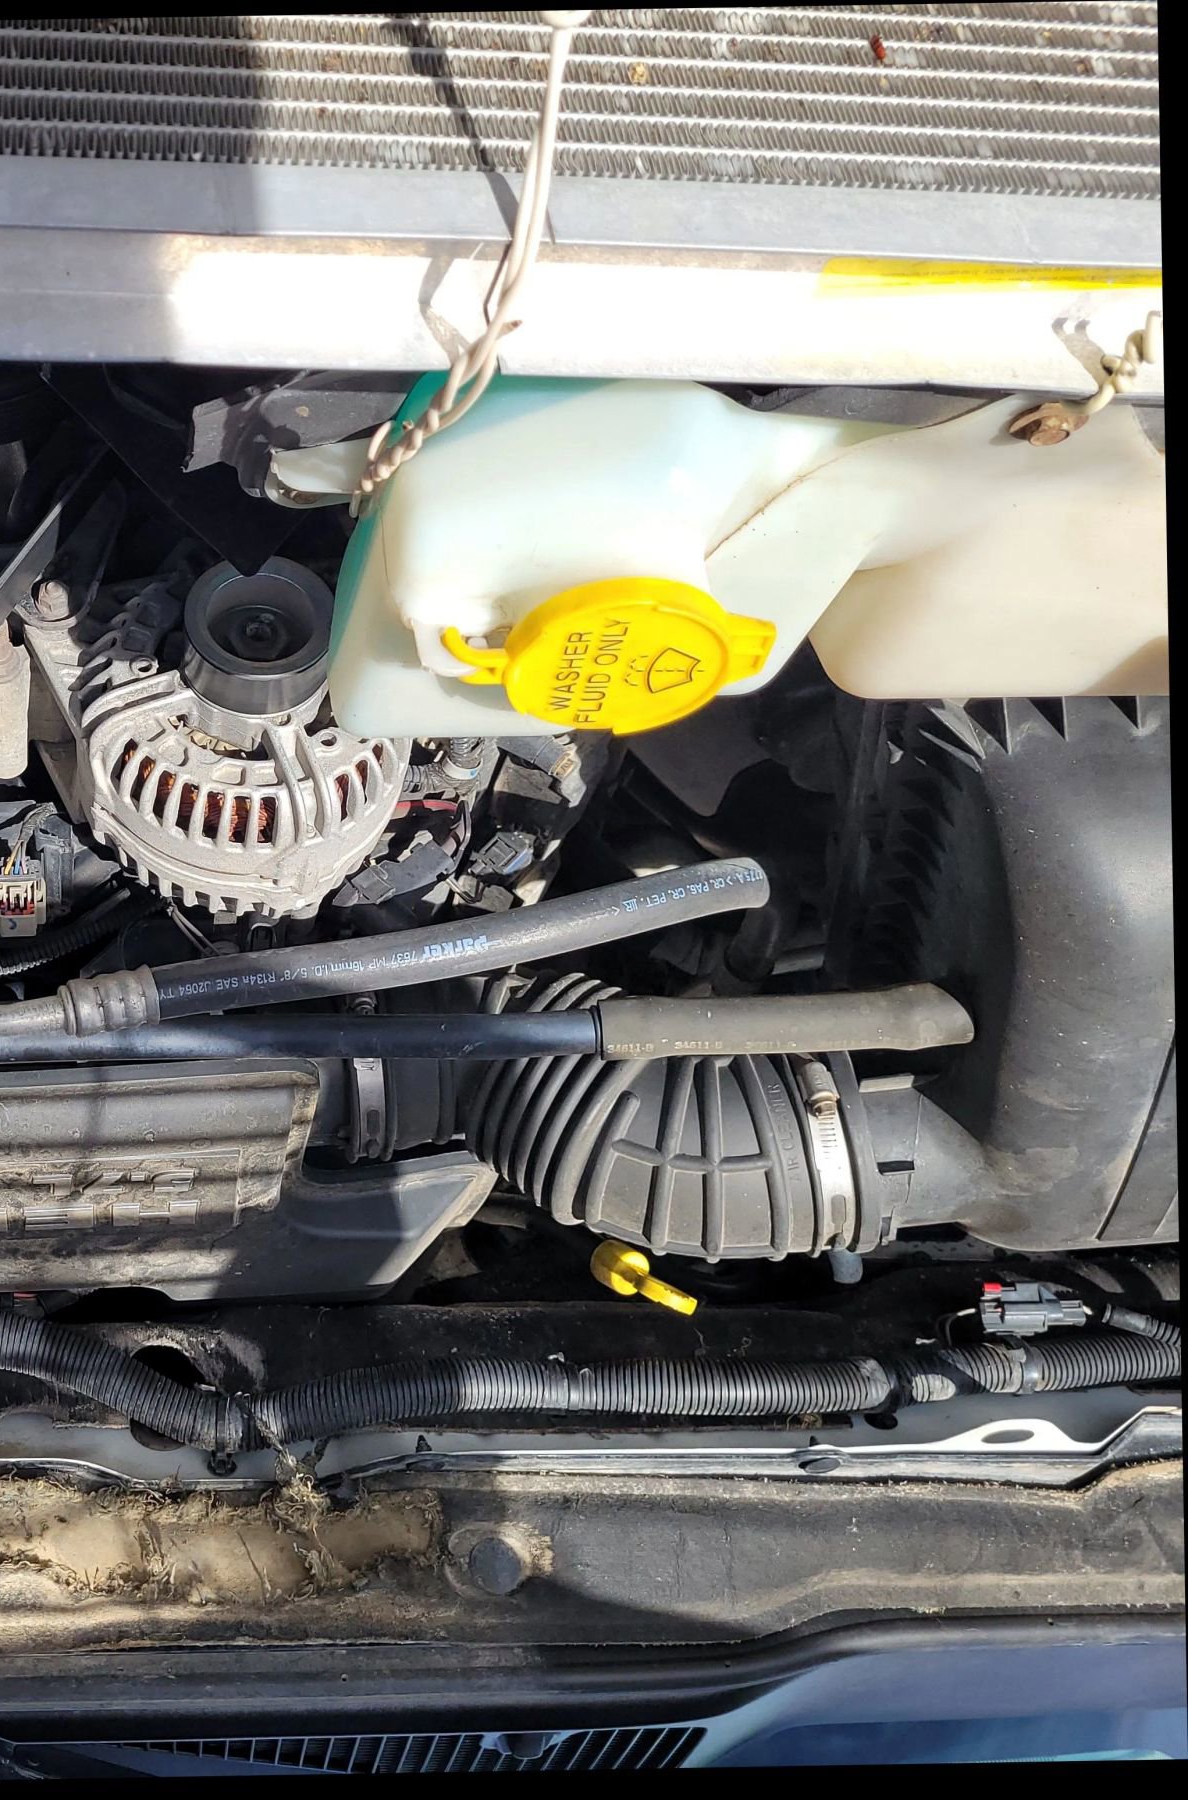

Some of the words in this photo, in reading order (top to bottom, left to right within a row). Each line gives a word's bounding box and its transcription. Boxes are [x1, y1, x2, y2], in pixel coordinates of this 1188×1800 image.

[549, 632, 592, 711] WASHER
[575, 673, 611, 723] FLUID
[595, 618, 631, 666] ONLY
[422, 935, 488, 959] Parker
[331, 959, 365, 972] 16mm
[369, 956, 386, 969] MP
[391, 950, 418, 965] 7637
[178, 980, 212, 996] J2064
[216, 977, 239, 991] SAE
[30, 1168, 198, 1198] 5.7L
